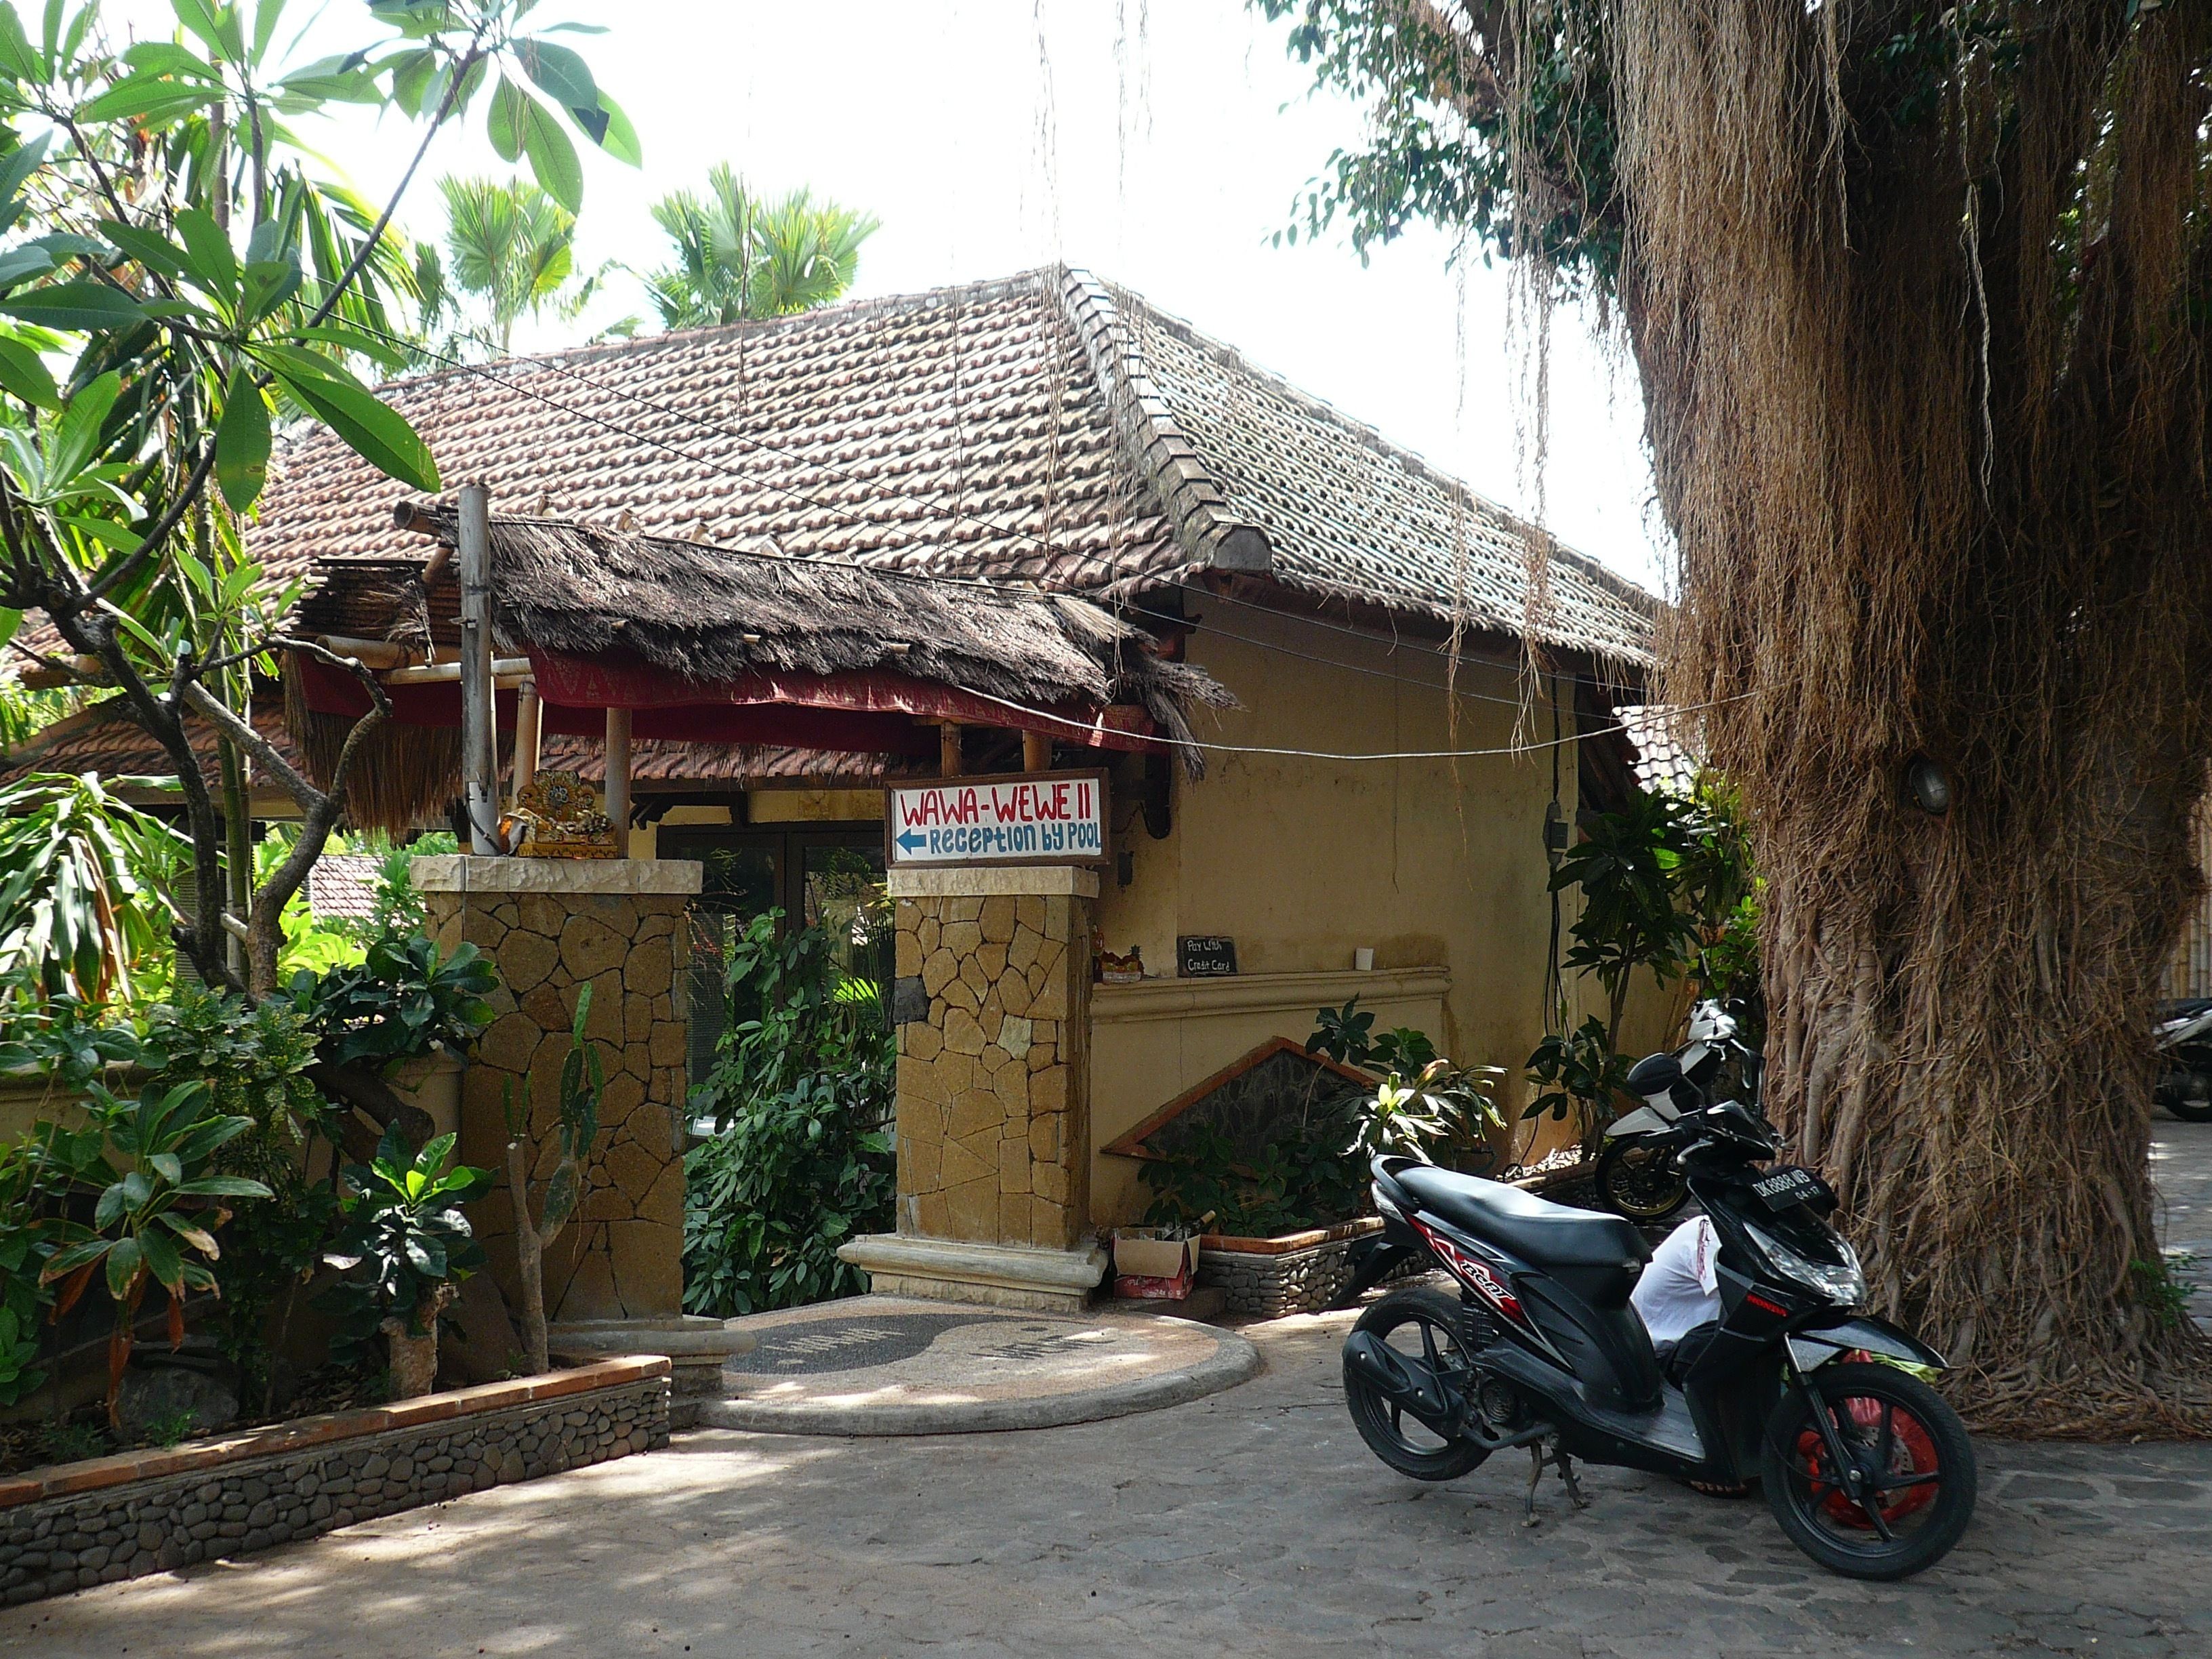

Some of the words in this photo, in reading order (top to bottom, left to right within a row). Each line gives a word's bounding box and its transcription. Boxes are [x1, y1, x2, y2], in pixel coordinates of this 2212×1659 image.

[900, 783, 1071, 827] WAWA-WEWE
[1067, 821, 1102, 850] POOL
[1187, 939, 1202, 952] Pay
[1187, 958, 1210, 972] Credit
[1211, 959, 1231, 972] Card
[1751, 1181, 1775, 1197] DK
